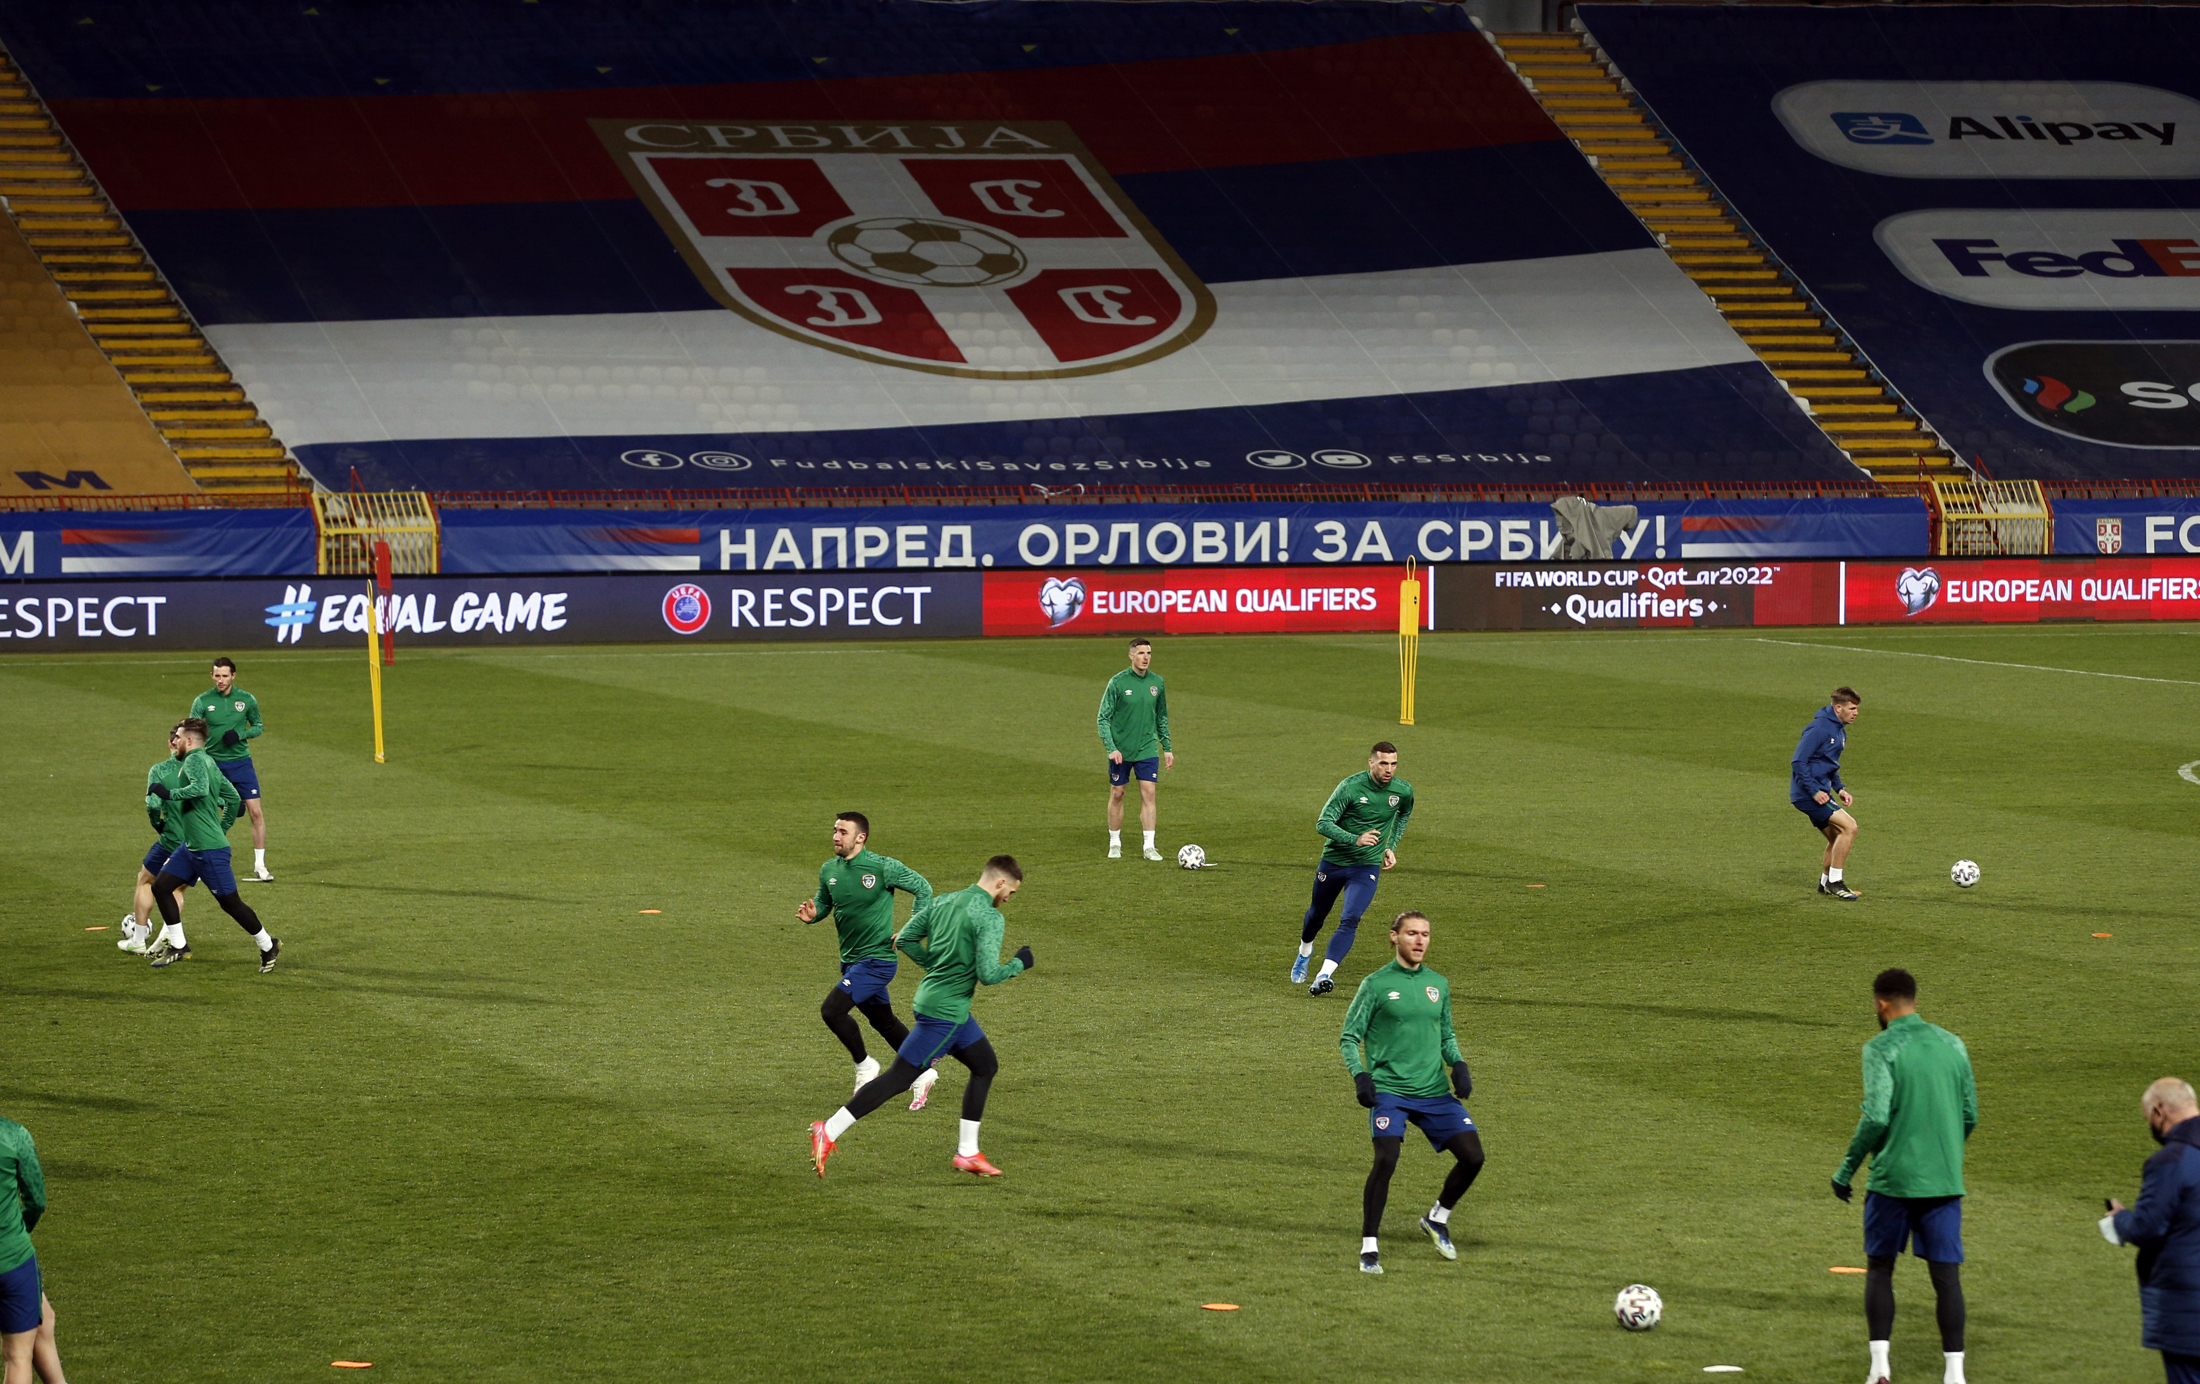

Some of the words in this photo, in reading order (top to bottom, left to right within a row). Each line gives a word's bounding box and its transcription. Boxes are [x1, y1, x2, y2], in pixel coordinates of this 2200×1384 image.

[624, 123, 1056, 149] СРБИЈА
[1948, 114, 2176, 146] Alipay
[769, 457, 1212, 471] FudbalskiSavezSrbije
[719, 524, 994, 570] НАПРЕД.
[1017, 517, 1290, 566] ОРЛОВИ!
[1312, 520, 1394, 562] ЗА
[1417, 514, 1667, 561] СРБИУ!
[1494, 570, 1534, 588] FIFA
[1534, 569, 1602, 587] WORLD
[1603, 569, 1640, 587] CUP
[1946, 578, 2072, 603] EUROPEAN
[2080, 577, 2200, 602] QUALIFIER
[671, 587, 701, 599] UEFA
[1092, 588, 1228, 614] EUROPEAN
[1235, 586, 1377, 613] QUALIFIERS
[730, 586, 932, 628] RESPECT
[1565, 592, 1704, 625] Qualifiers
